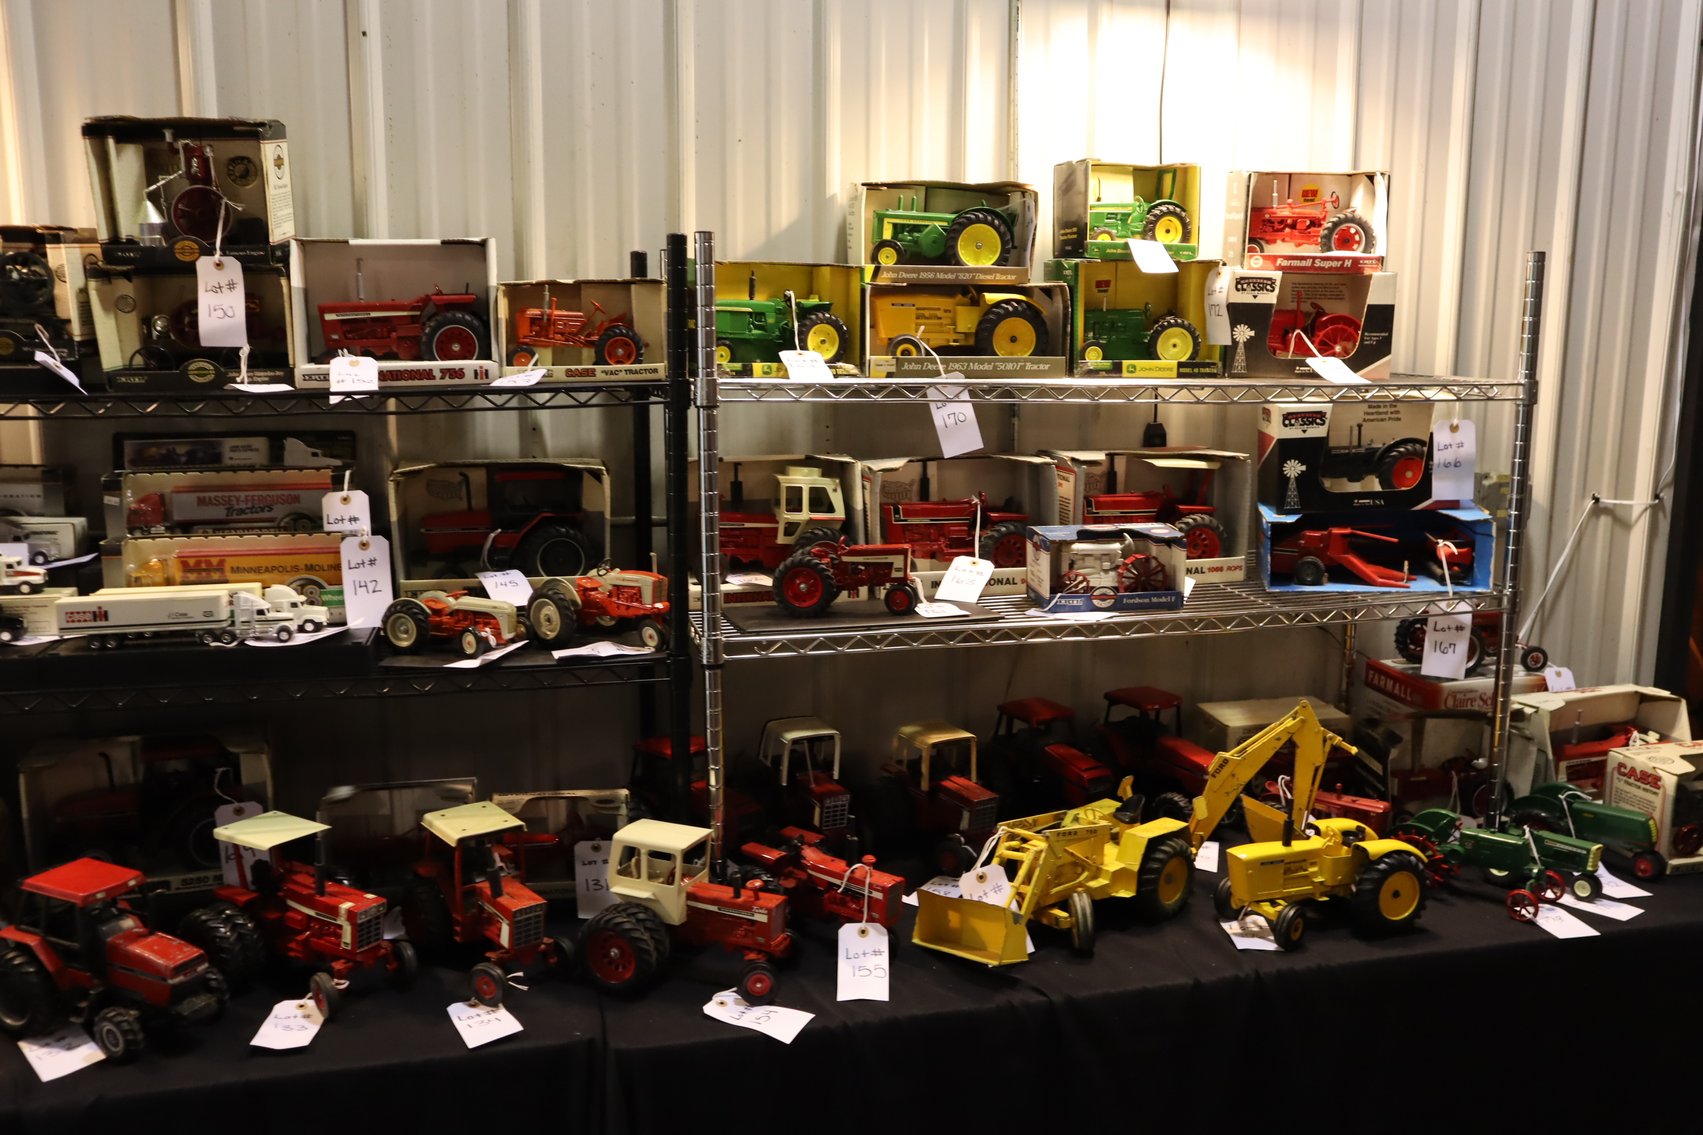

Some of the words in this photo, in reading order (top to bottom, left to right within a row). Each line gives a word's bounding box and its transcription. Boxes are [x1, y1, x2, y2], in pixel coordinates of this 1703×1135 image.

[1276, 258, 1312, 267] Farmall
[1313, 258, 1339, 269] Super
[1340, 257, 1352, 267] H
[882, 271, 898, 281] John
[898, 271, 918, 280] Deere
[936, 271, 956, 280] Model
[975, 271, 994, 280] Diesel
[995, 272, 1017, 281] Tractor
[1235, 281, 1277, 292] CLASSICS
[207, 304, 235, 319] 150
[1208, 304, 1223, 317] 172
[565, 367, 597, 378] CASE
[624, 367, 659, 376] TRACTOR
[902, 362, 921, 371] John
[948, 362, 967, 371] 1963
[969, 362, 993, 371] Model
[1025, 362, 1051, 371] Tractor
[942, 411, 967, 429] 170
[1282, 416, 1327, 427] CLASSICS
[1437, 457, 1462, 469] 166
[197, 494, 300, 507] MASSEY-FERGUSON
[225, 504, 274, 518] Tractors
[353, 579, 382, 596] 142
[495, 580, 519, 588] 145
[1122, 596, 1147, 604] Fordson
[1149, 595, 1170, 603] Model
[1434, 642, 1456, 654] 167
[1367, 669, 1412, 701] FARMALL
[1444, 695, 1478, 711] Claire
[1211, 758, 1230, 779] FORD
[1616, 762, 1663, 790] CASE
[852, 964, 887, 979] 155
